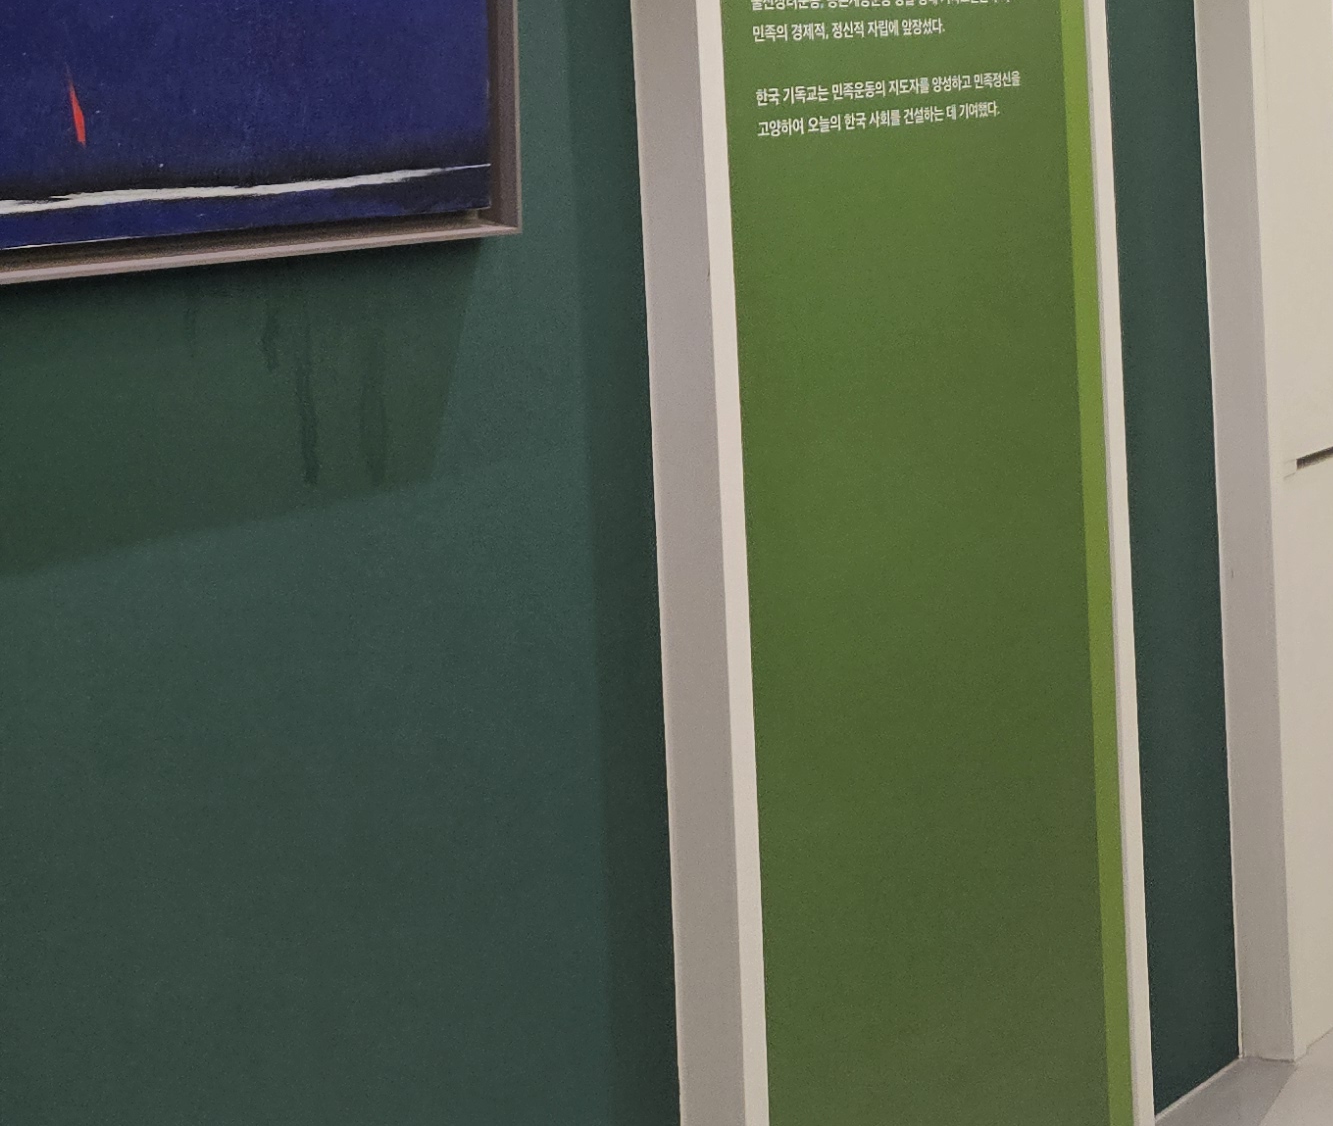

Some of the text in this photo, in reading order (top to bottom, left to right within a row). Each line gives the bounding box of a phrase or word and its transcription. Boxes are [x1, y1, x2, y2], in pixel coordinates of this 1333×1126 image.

[752, 18, 945, 43] 민족의 경제적, 정신적 자립에 앞장섰다.
[756, 70, 1021, 107] 한국 기독교는 민족운동의 지도자를 양성하고 민족정신을
[757, 101, 1000, 137] 고양하여 오늘의 한국 사회를 건설하는 데 기여했다.
